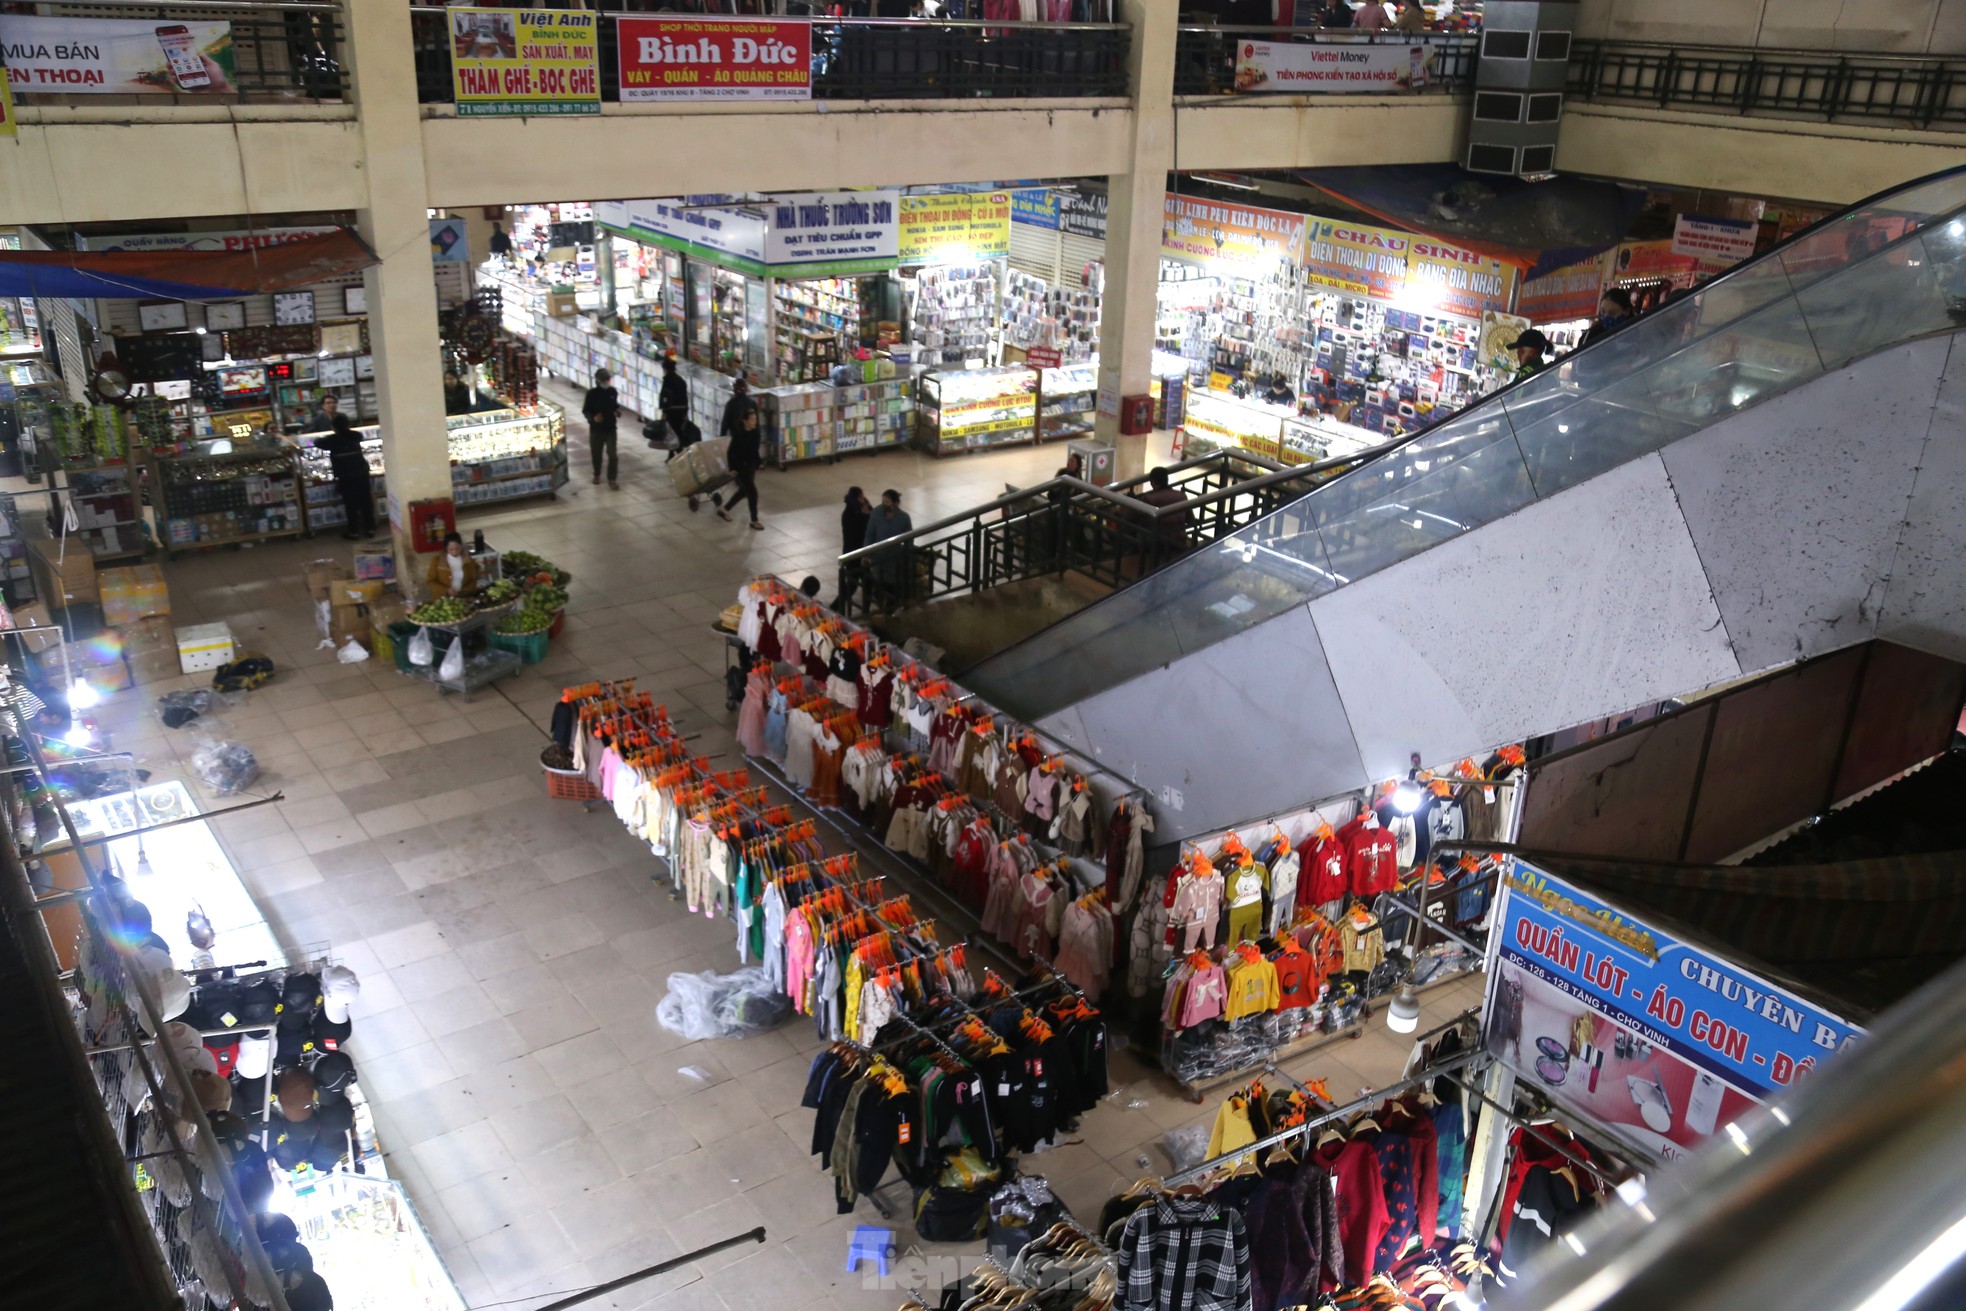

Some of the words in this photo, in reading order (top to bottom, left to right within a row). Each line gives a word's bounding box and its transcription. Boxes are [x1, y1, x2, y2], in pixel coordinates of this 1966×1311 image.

[520, 13, 553, 27] Việt
[559, 14, 592, 26] Anh
[659, 24, 682, 32] SHOP
[705, 24, 731, 32] TRANG
[1, 44, 50, 60] MUA
[54, 41, 100, 60] BÁN
[522, 40, 542, 59] SẢN
[574, 46, 593, 59] MAY
[638, 36, 722, 64] Bình
[732, 38, 797, 64] Đức
[1311, 51, 1339, 62] Viettel
[1340, 51, 1370, 64] Money
[34, 68, 104, 87] THOẠI
[570, 64, 596, 94] GHẾ
[1296, 70, 1324, 80] PHONG
[1345, 71, 1360, 82] TẠO
[460, 105, 471, 114] 71
[776, 200, 796, 229] NHÀ
[799, 196, 829, 228] THUỐC
[1186, 203, 1208, 219] LINH
[784, 235, 803, 246] ĐẠT
[808, 232, 827, 243] TIÊU
[865, 231, 883, 239] GPP
[1334, 228, 1407, 250] CHÂU
[1414, 243, 1483, 265] SINH
[1311, 240, 1333, 266] ĐIỆN
[1336, 243, 1363, 271] THOẠI
[1366, 252, 1377, 270] DI
[1379, 253, 1406, 279] ĐỘNG
[1471, 272, 1503, 300] NHẠC
[1310, 276, 1323, 285] LOA
[1345, 283, 1366, 293] MICRO
[941, 426, 959, 437] NOKIA
[963, 423, 990, 434] SAMSUNG
[994, 420, 1022, 432] MOTOROLA
[1509, 953, 1527, 969] ĐC:
[1529, 963, 1545, 978] 126
[1553, 976, 1569, 991] 128
[1603, 1004, 1608, 1013] 1
[1644, 1026, 1670, 1047] VINH
[1516, 917, 1580, 973] QUẦN
[1583, 953, 1629, 998] LÓT
[1647, 984, 1685, 1028] ÁO
[1690, 1010, 1749, 1064] CON
[1680, 957, 1805, 1034] CHUYÊN
[1812, 1022, 1858, 1055] BÁ
